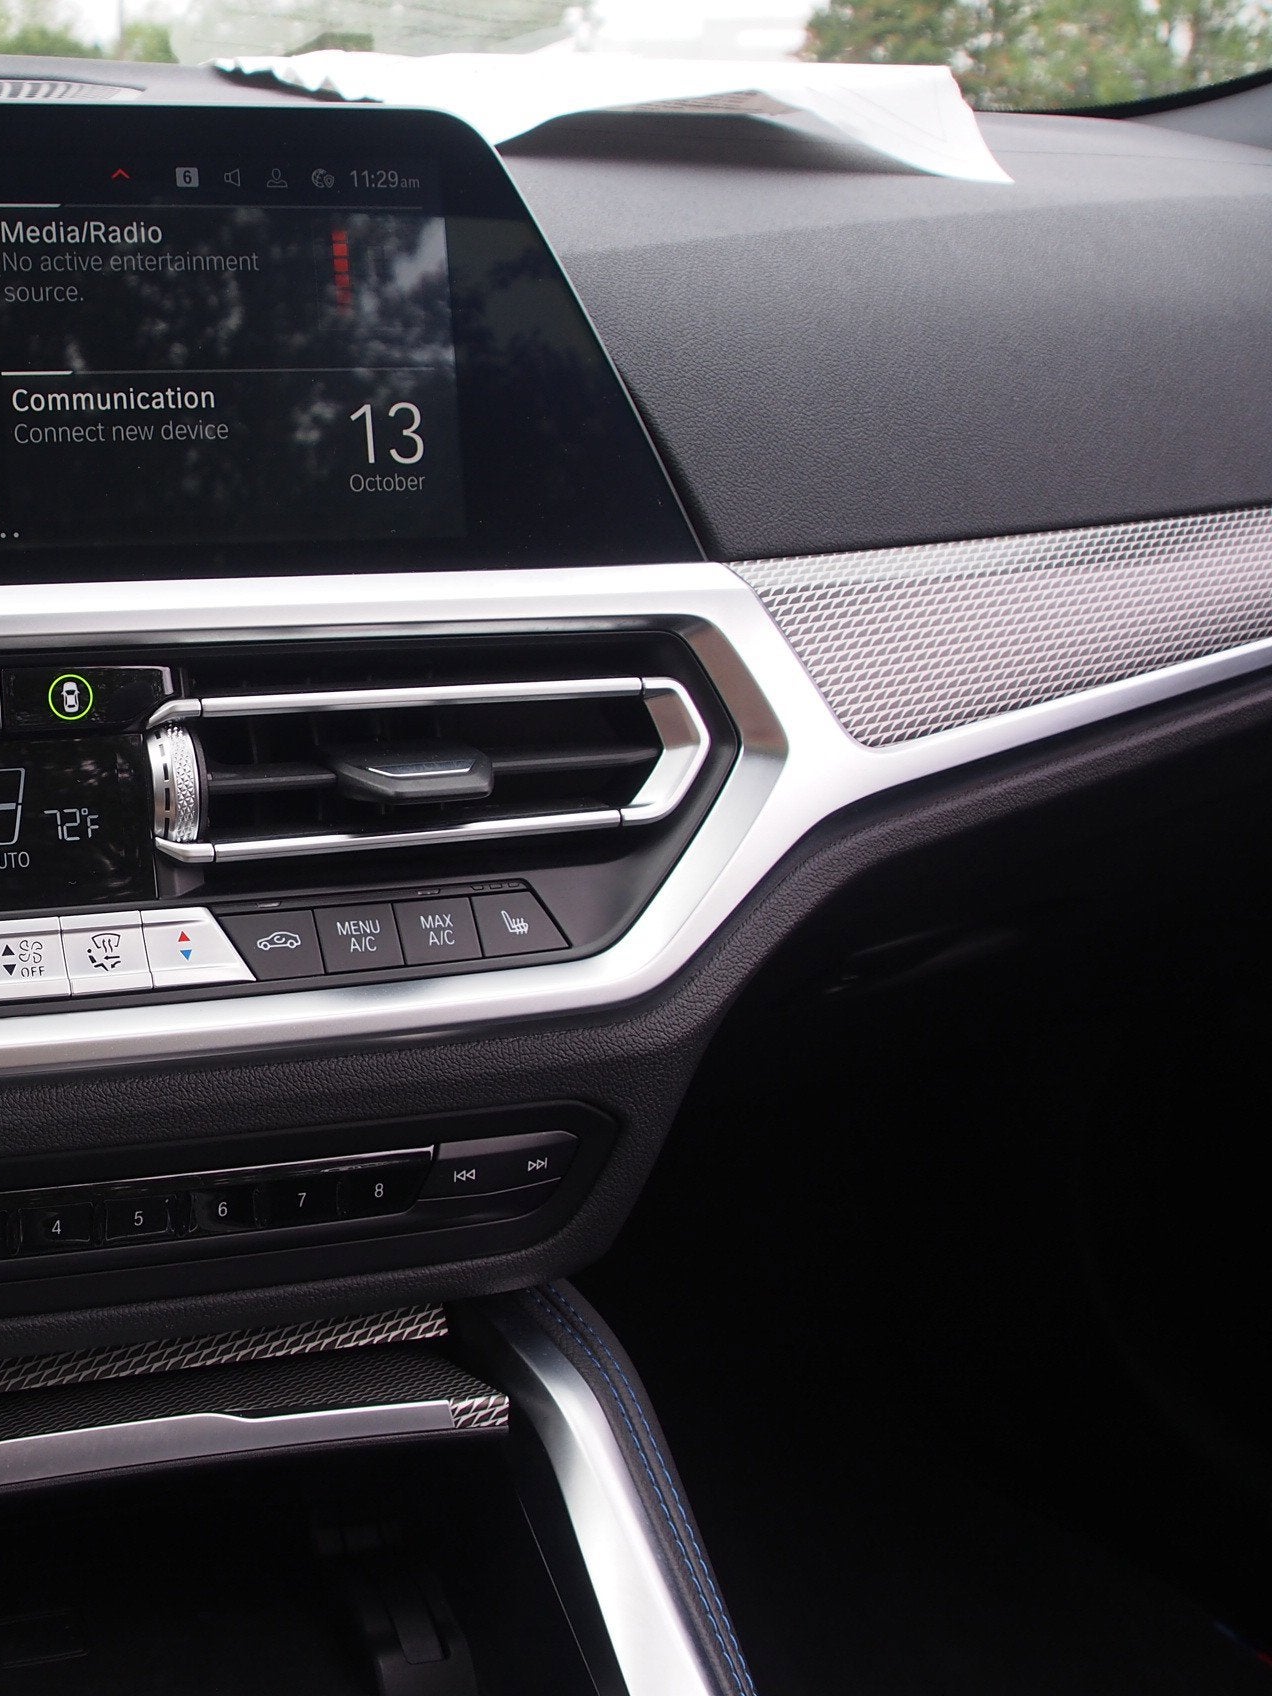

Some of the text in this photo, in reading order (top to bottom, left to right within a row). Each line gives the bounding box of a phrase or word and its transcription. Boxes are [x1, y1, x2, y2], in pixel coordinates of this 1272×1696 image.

[0, 221, 163, 244] Media/Radio
[3, 250, 260, 272] No active entertainment
[4, 284, 85, 303] source.
[12, 387, 216, 412] Communication
[14, 421, 229, 443] Connect new device
[349, 401, 425, 465] 13
[349, 473, 426, 492] October
[336, 919, 381, 936] MENU
[420, 913, 454, 929] MAX
[350, 936, 377, 952] A/C
[429, 930, 455, 946] A/C
[21, 965, 45, 978] OFF
[374, 1183, 384, 1198] 8
[297, 1192, 307, 1208] 7
[218, 1202, 228, 1217] 6
[51, 1219, 62, 1234] 4
[134, 1211, 144, 1226] 5
